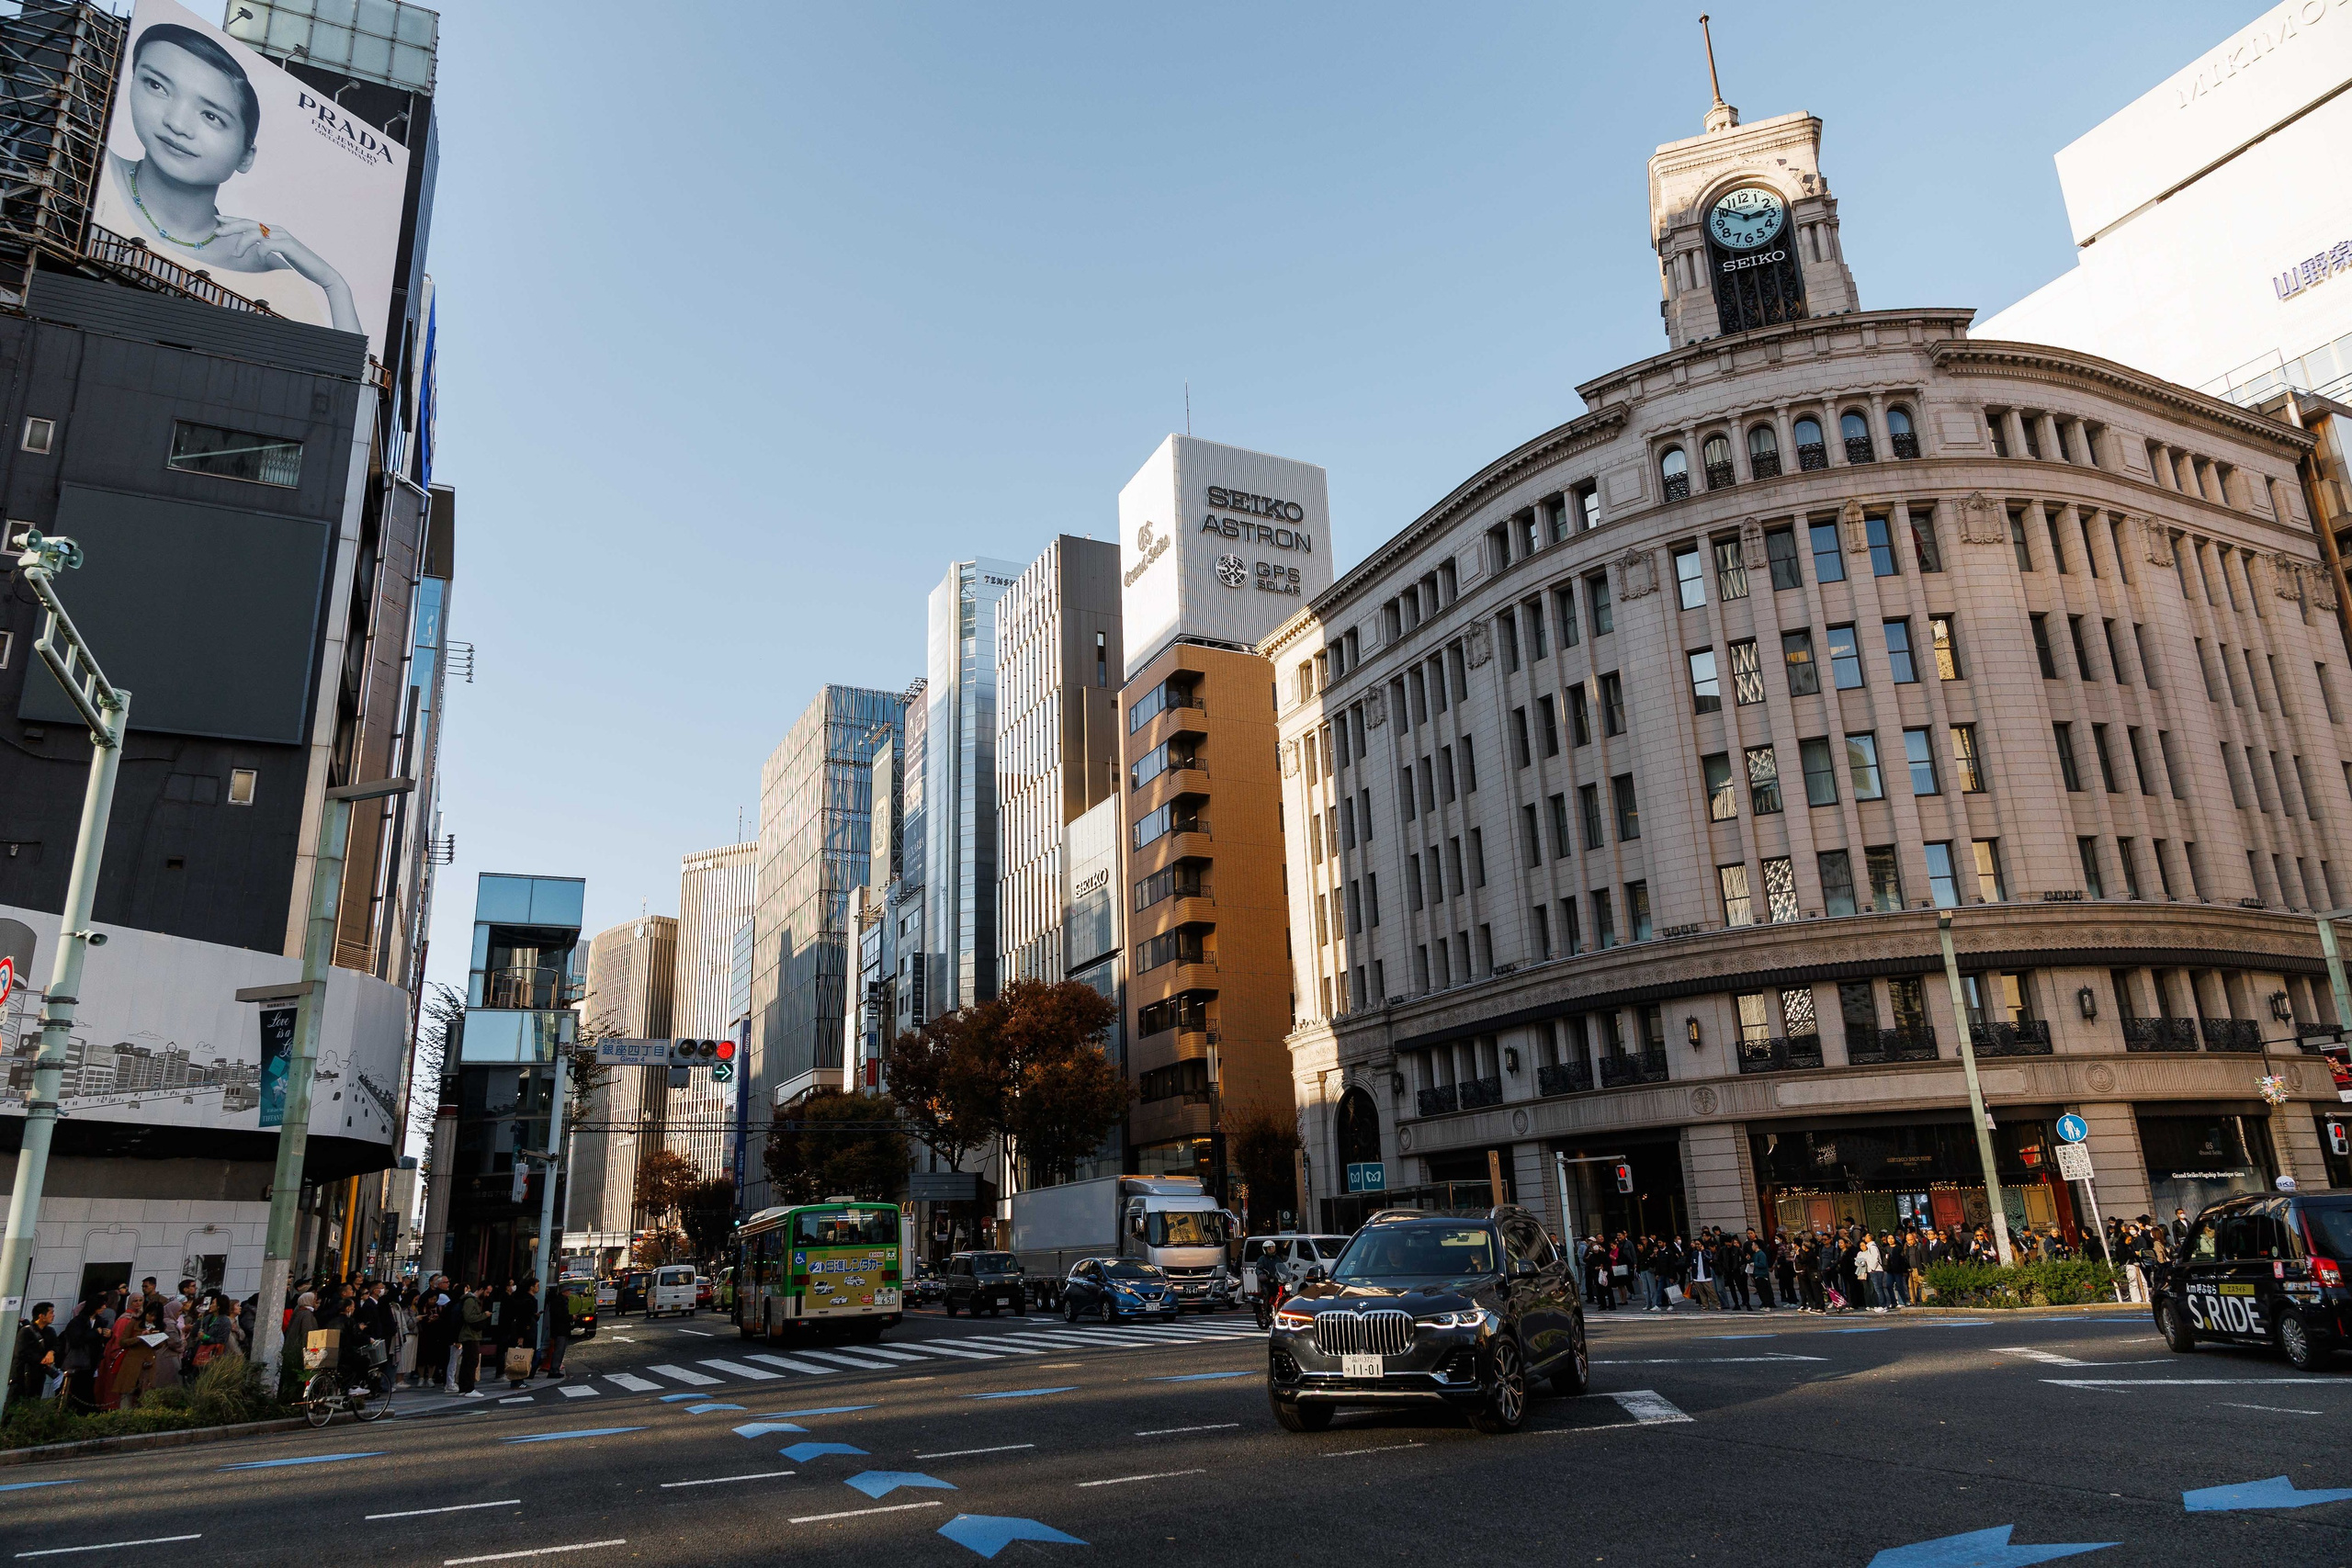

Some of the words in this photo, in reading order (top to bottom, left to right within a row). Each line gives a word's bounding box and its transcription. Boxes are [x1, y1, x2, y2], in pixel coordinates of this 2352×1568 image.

[2177, 0, 2348, 109] MIKIMO
[298, 91, 394, 165] PRADA
[311, 118, 334, 137] FINE
[335, 133, 379, 164] JEWELRY
[315, 129, 346, 150] COULEUR
[347, 147, 374, 167] VIVANTE
[1727, 198, 1736, 209] 11
[1738, 193, 1748, 204] 12
[1754, 194, 1758, 203] 1
[1761, 198, 1771, 209] 2
[1718, 209, 1728, 219] 10
[1768, 208, 1777, 218] 3
[1716, 220, 1725, 230] 9
[1765, 219, 1774, 228] 4
[1722, 228, 1731, 238] 8
[1733, 232, 1742, 243] 7
[1745, 233, 1754, 243] 6
[1756, 228, 1765, 238] 5
[1723, 250, 1785, 273] SEIKO
[1207, 485, 1304, 524] SEIKO
[1137, 520, 1154, 552] GS
[1201, 513, 1312, 554] ASTRON
[1124, 554, 1148, 588] Grand
[1147, 534, 1171, 565] Seiko
[1255, 561, 1301, 584] GPS
[1255, 578, 1301, 597] SOLAR
[1075, 867, 1109, 899] SEIKO
[267, 1011, 290, 1028] Love
[276, 1027, 284, 1038] is
[285, 1029, 291, 1038] a
[602, 1044, 664, 1056] 銀座四丁目
[825, 1258, 885, 1274] 日進レンタカー
[2187, 1293, 2267, 1335] S.RIDE
